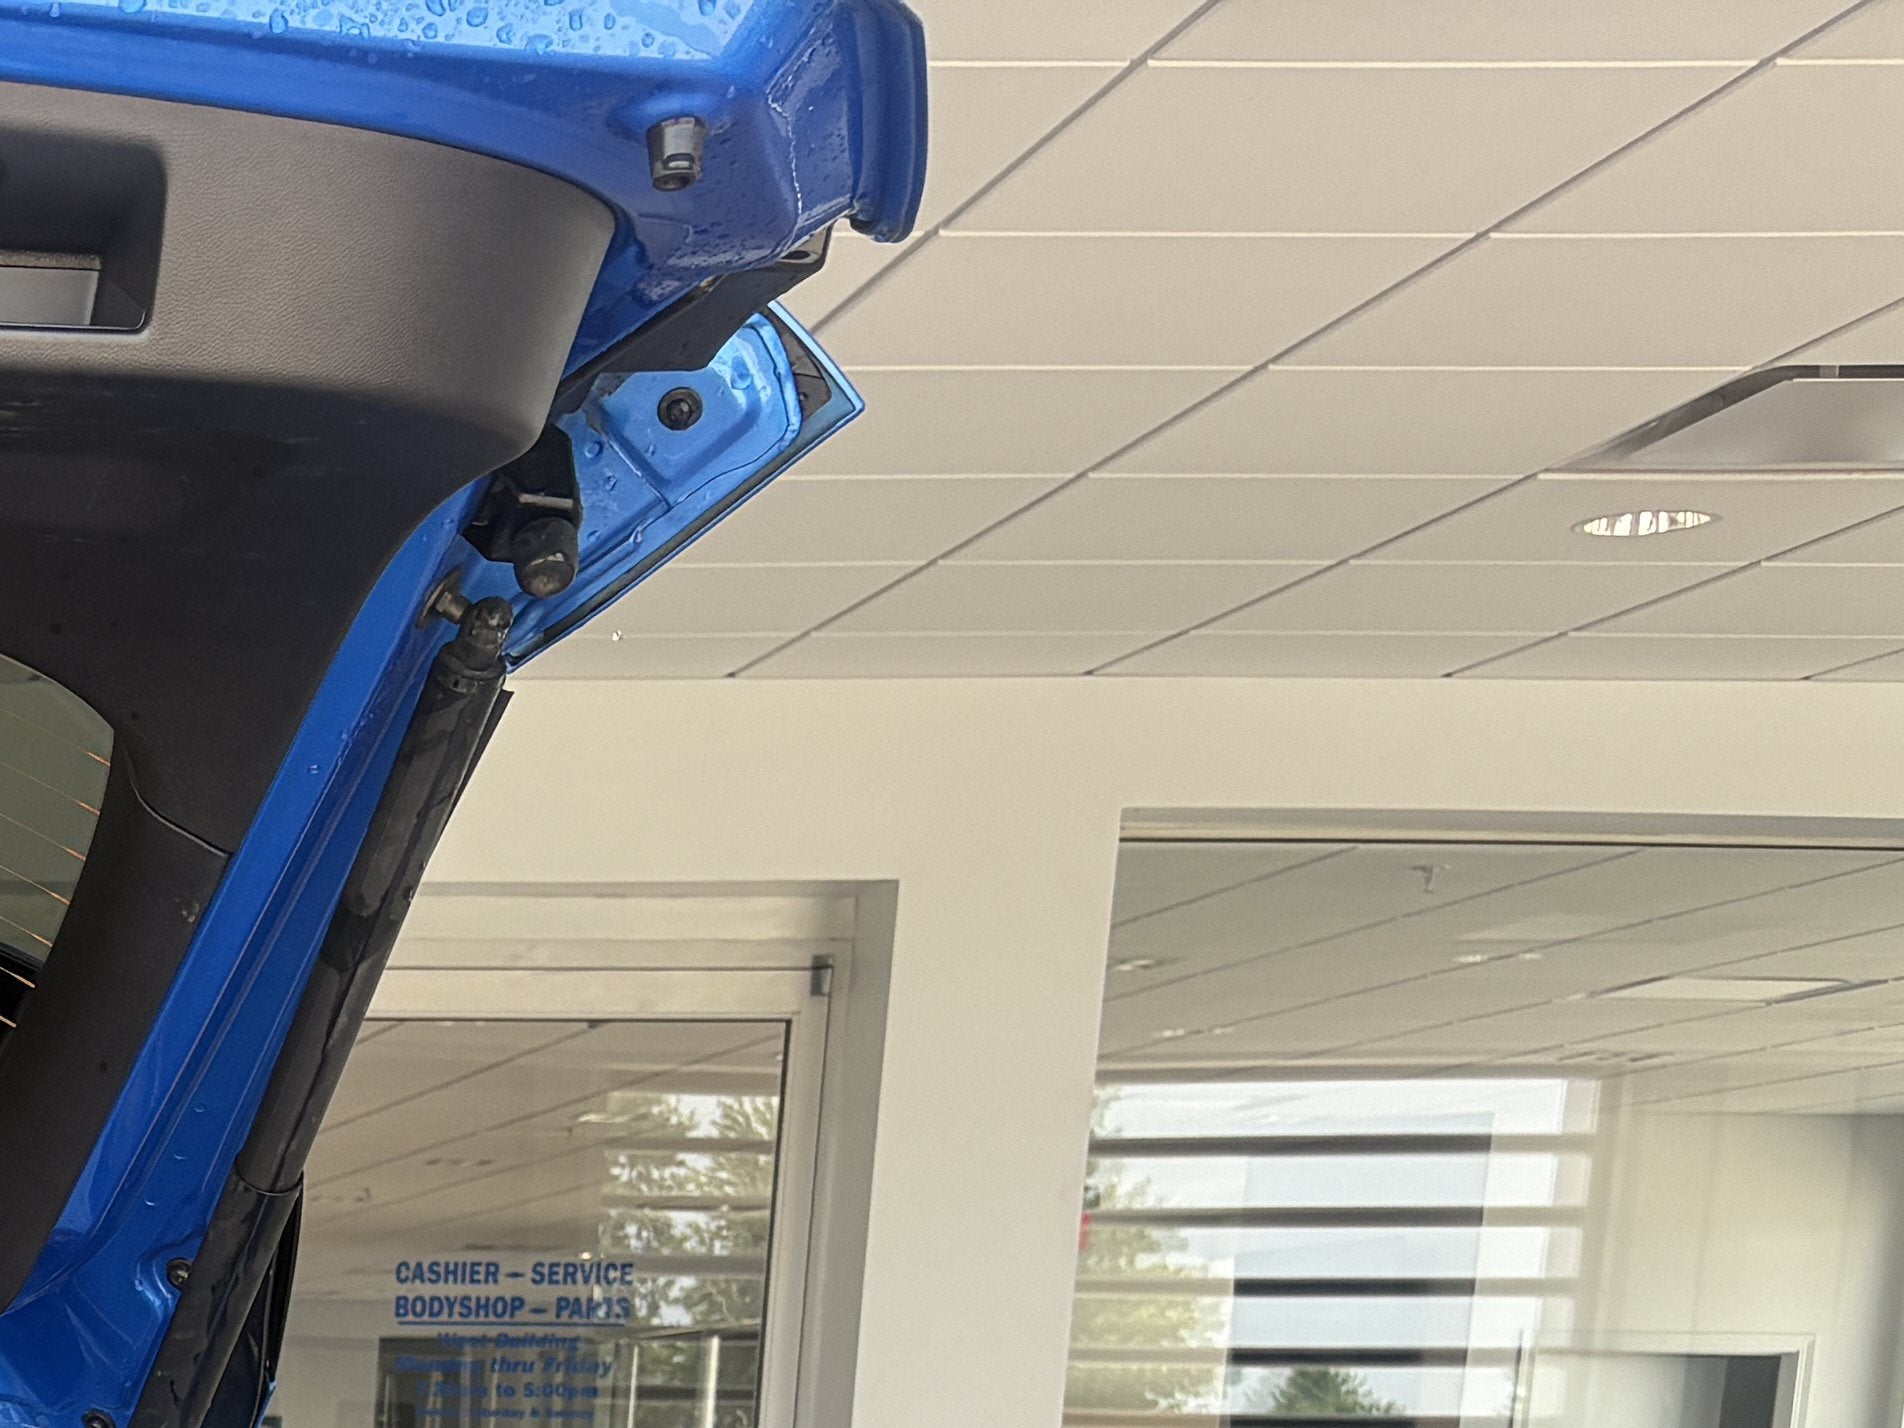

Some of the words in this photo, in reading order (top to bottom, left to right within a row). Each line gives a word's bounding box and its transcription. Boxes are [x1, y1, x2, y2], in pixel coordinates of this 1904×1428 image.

[395, 1261, 499, 1285] CASHIER
[531, 1261, 634, 1286] SERVICE
[395, 1295, 525, 1319] BODYSHOP
[492, 1357, 535, 1373] thru
